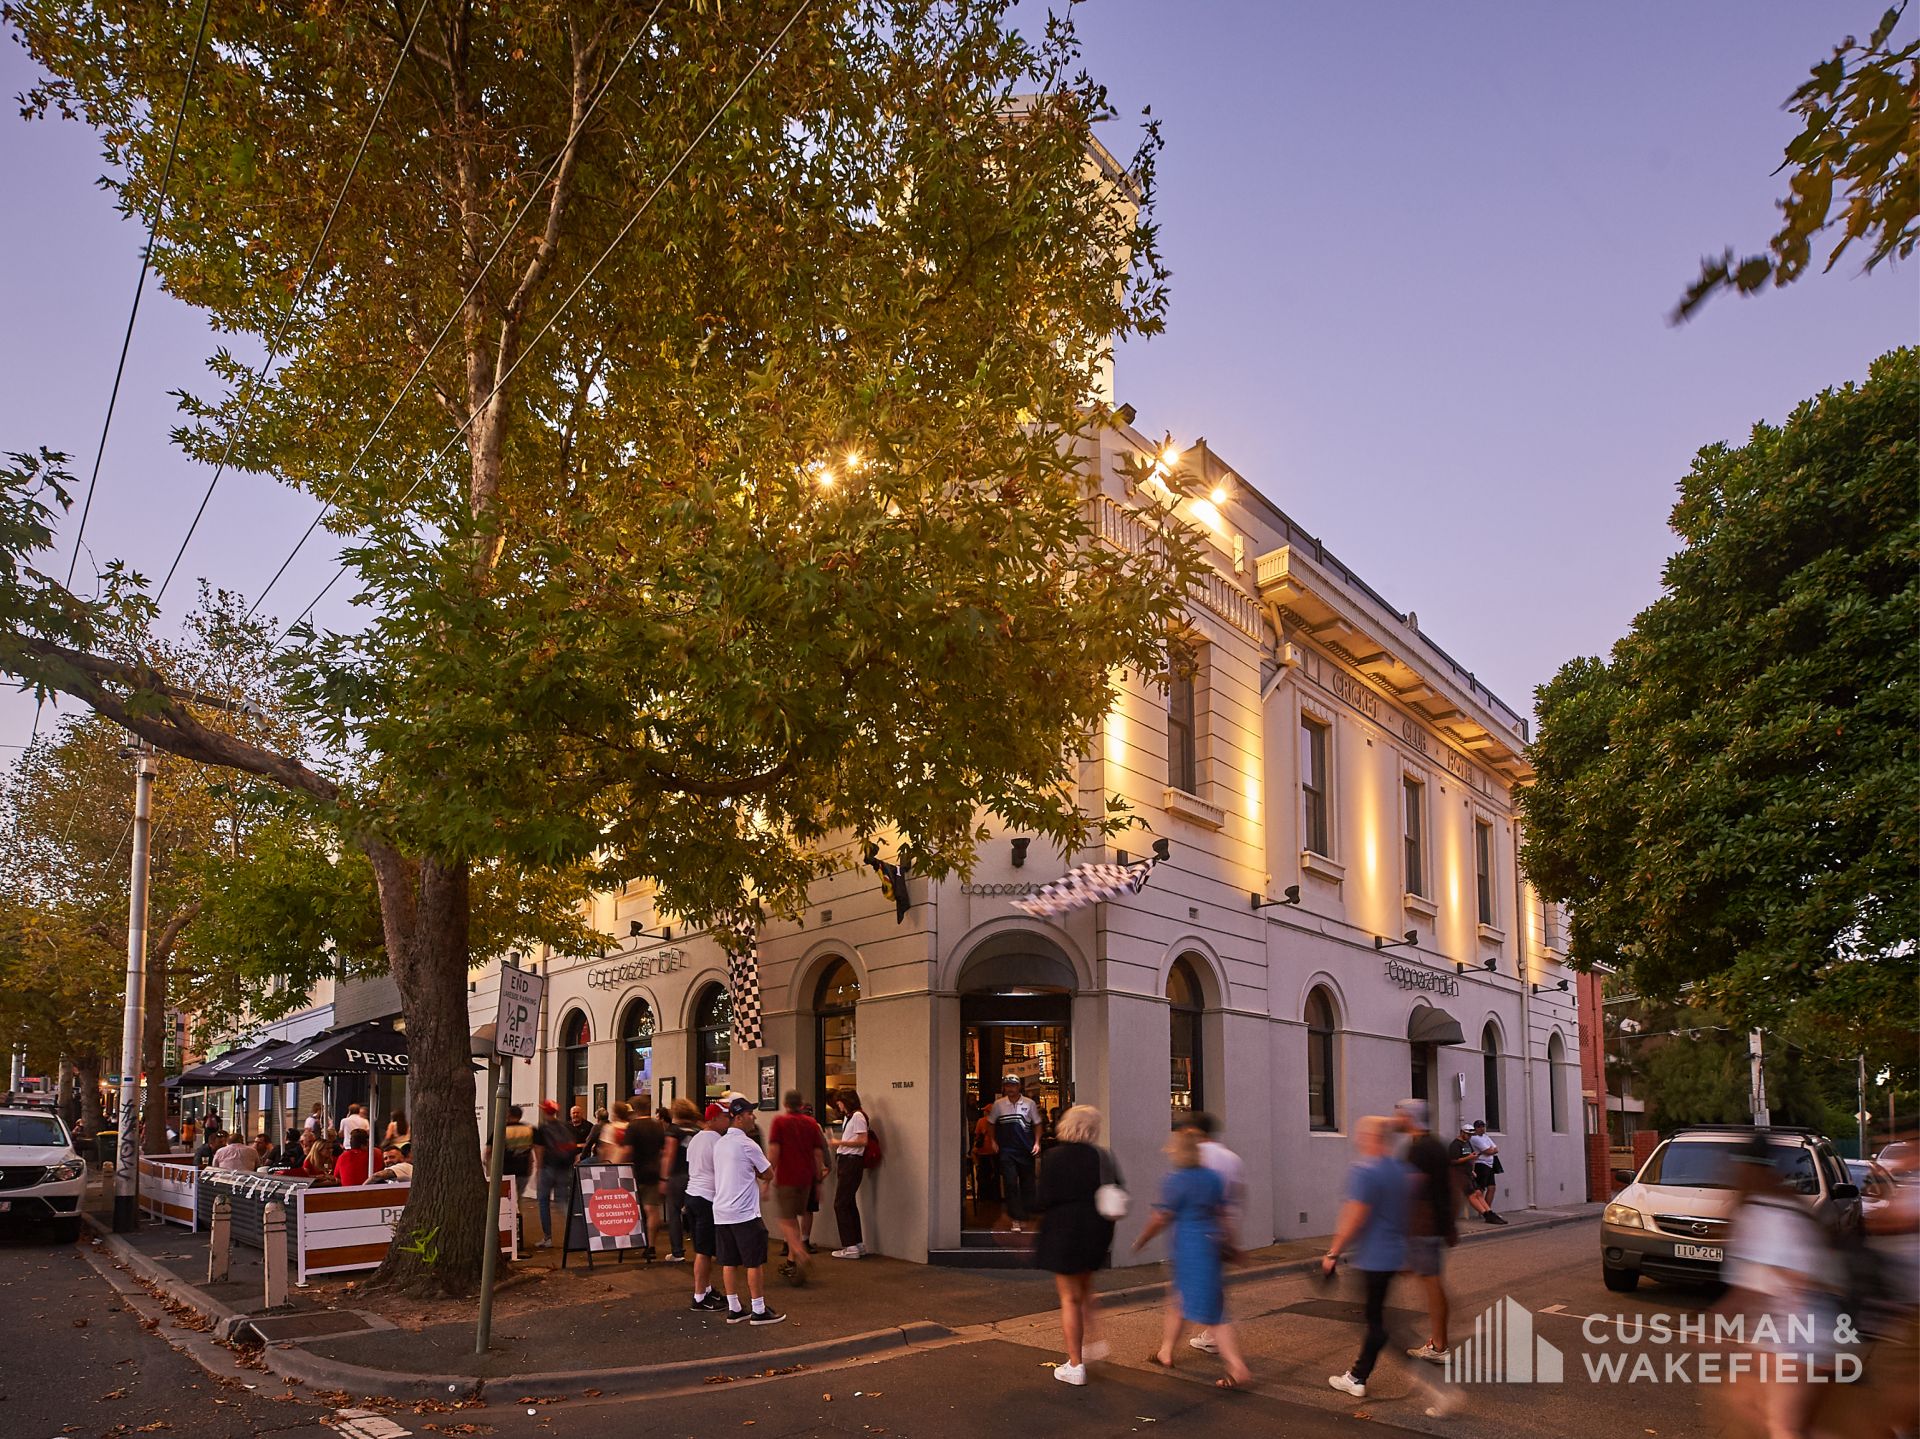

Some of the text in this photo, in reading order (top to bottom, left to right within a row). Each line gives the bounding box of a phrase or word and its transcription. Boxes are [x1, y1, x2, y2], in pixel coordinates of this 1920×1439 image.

[1333, 673, 1475, 785] CRICKET CLUB HOTEL
[511, 976, 529, 993] END
[167, 1016, 175, 1065] FLOWERS
